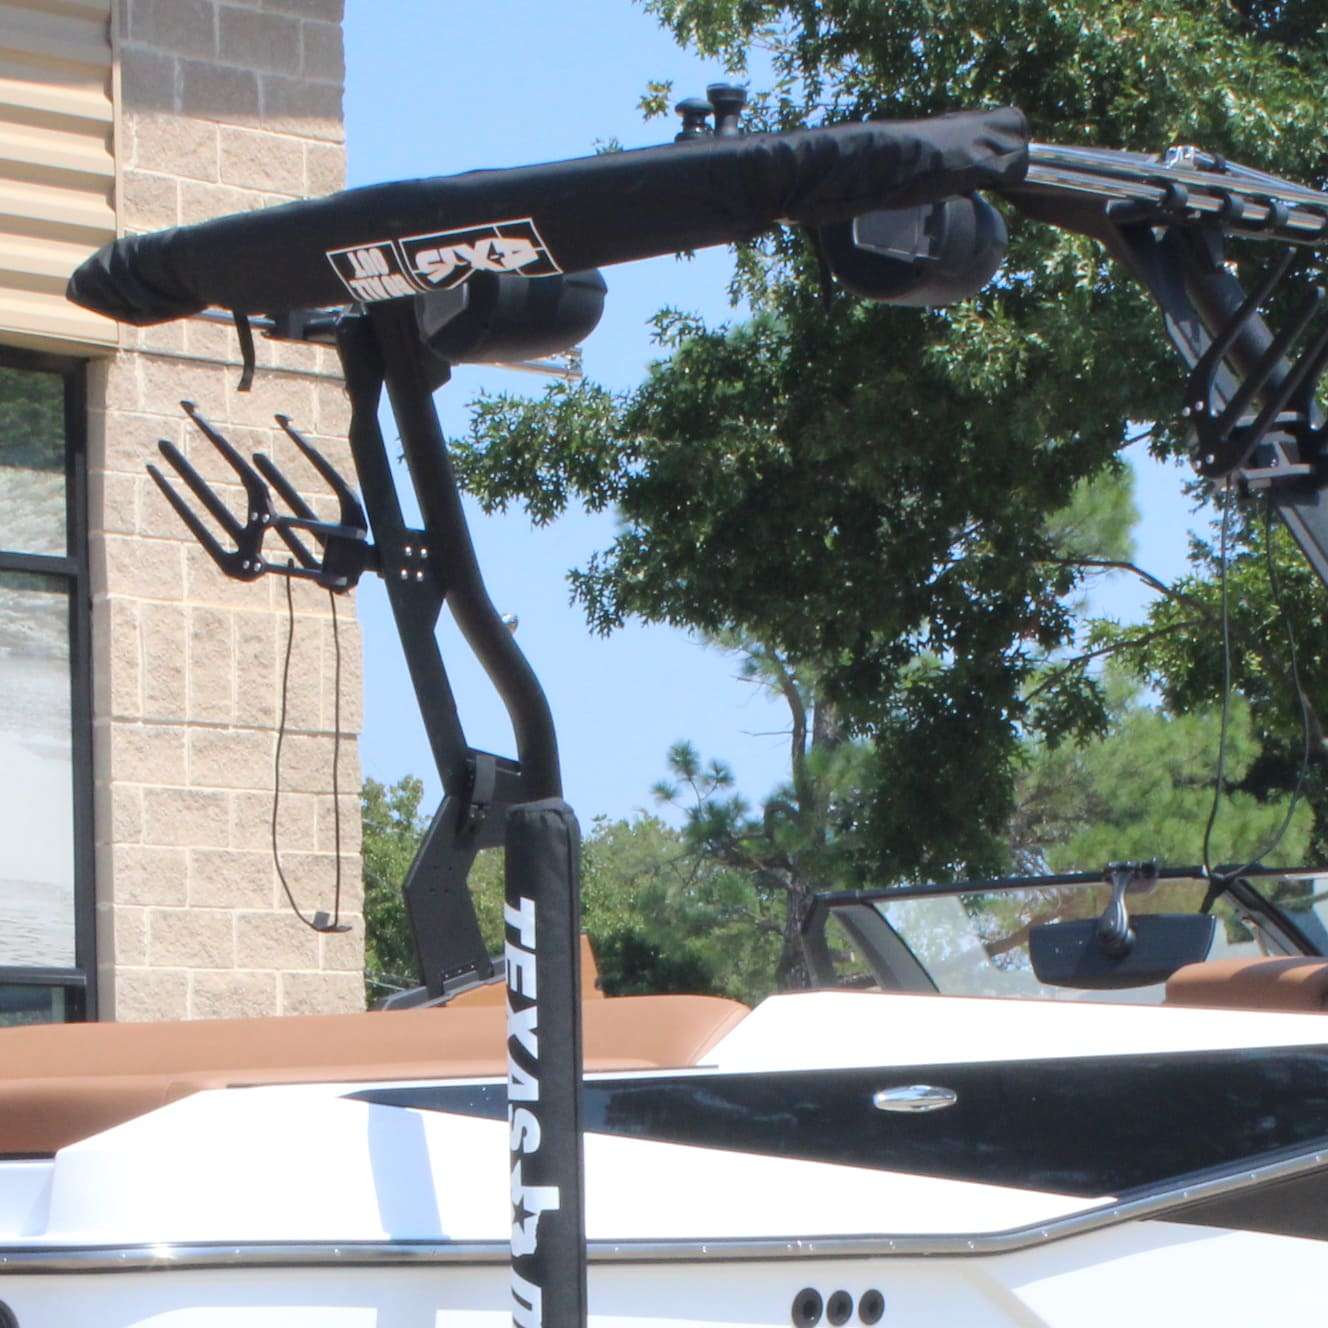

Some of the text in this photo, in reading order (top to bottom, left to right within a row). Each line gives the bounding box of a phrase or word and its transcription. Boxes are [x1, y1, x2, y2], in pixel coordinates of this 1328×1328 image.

[347, 248, 389, 278] OUT
[415, 237, 539, 284] AXIS
[504, 896, 541, 1154] TEXAS
